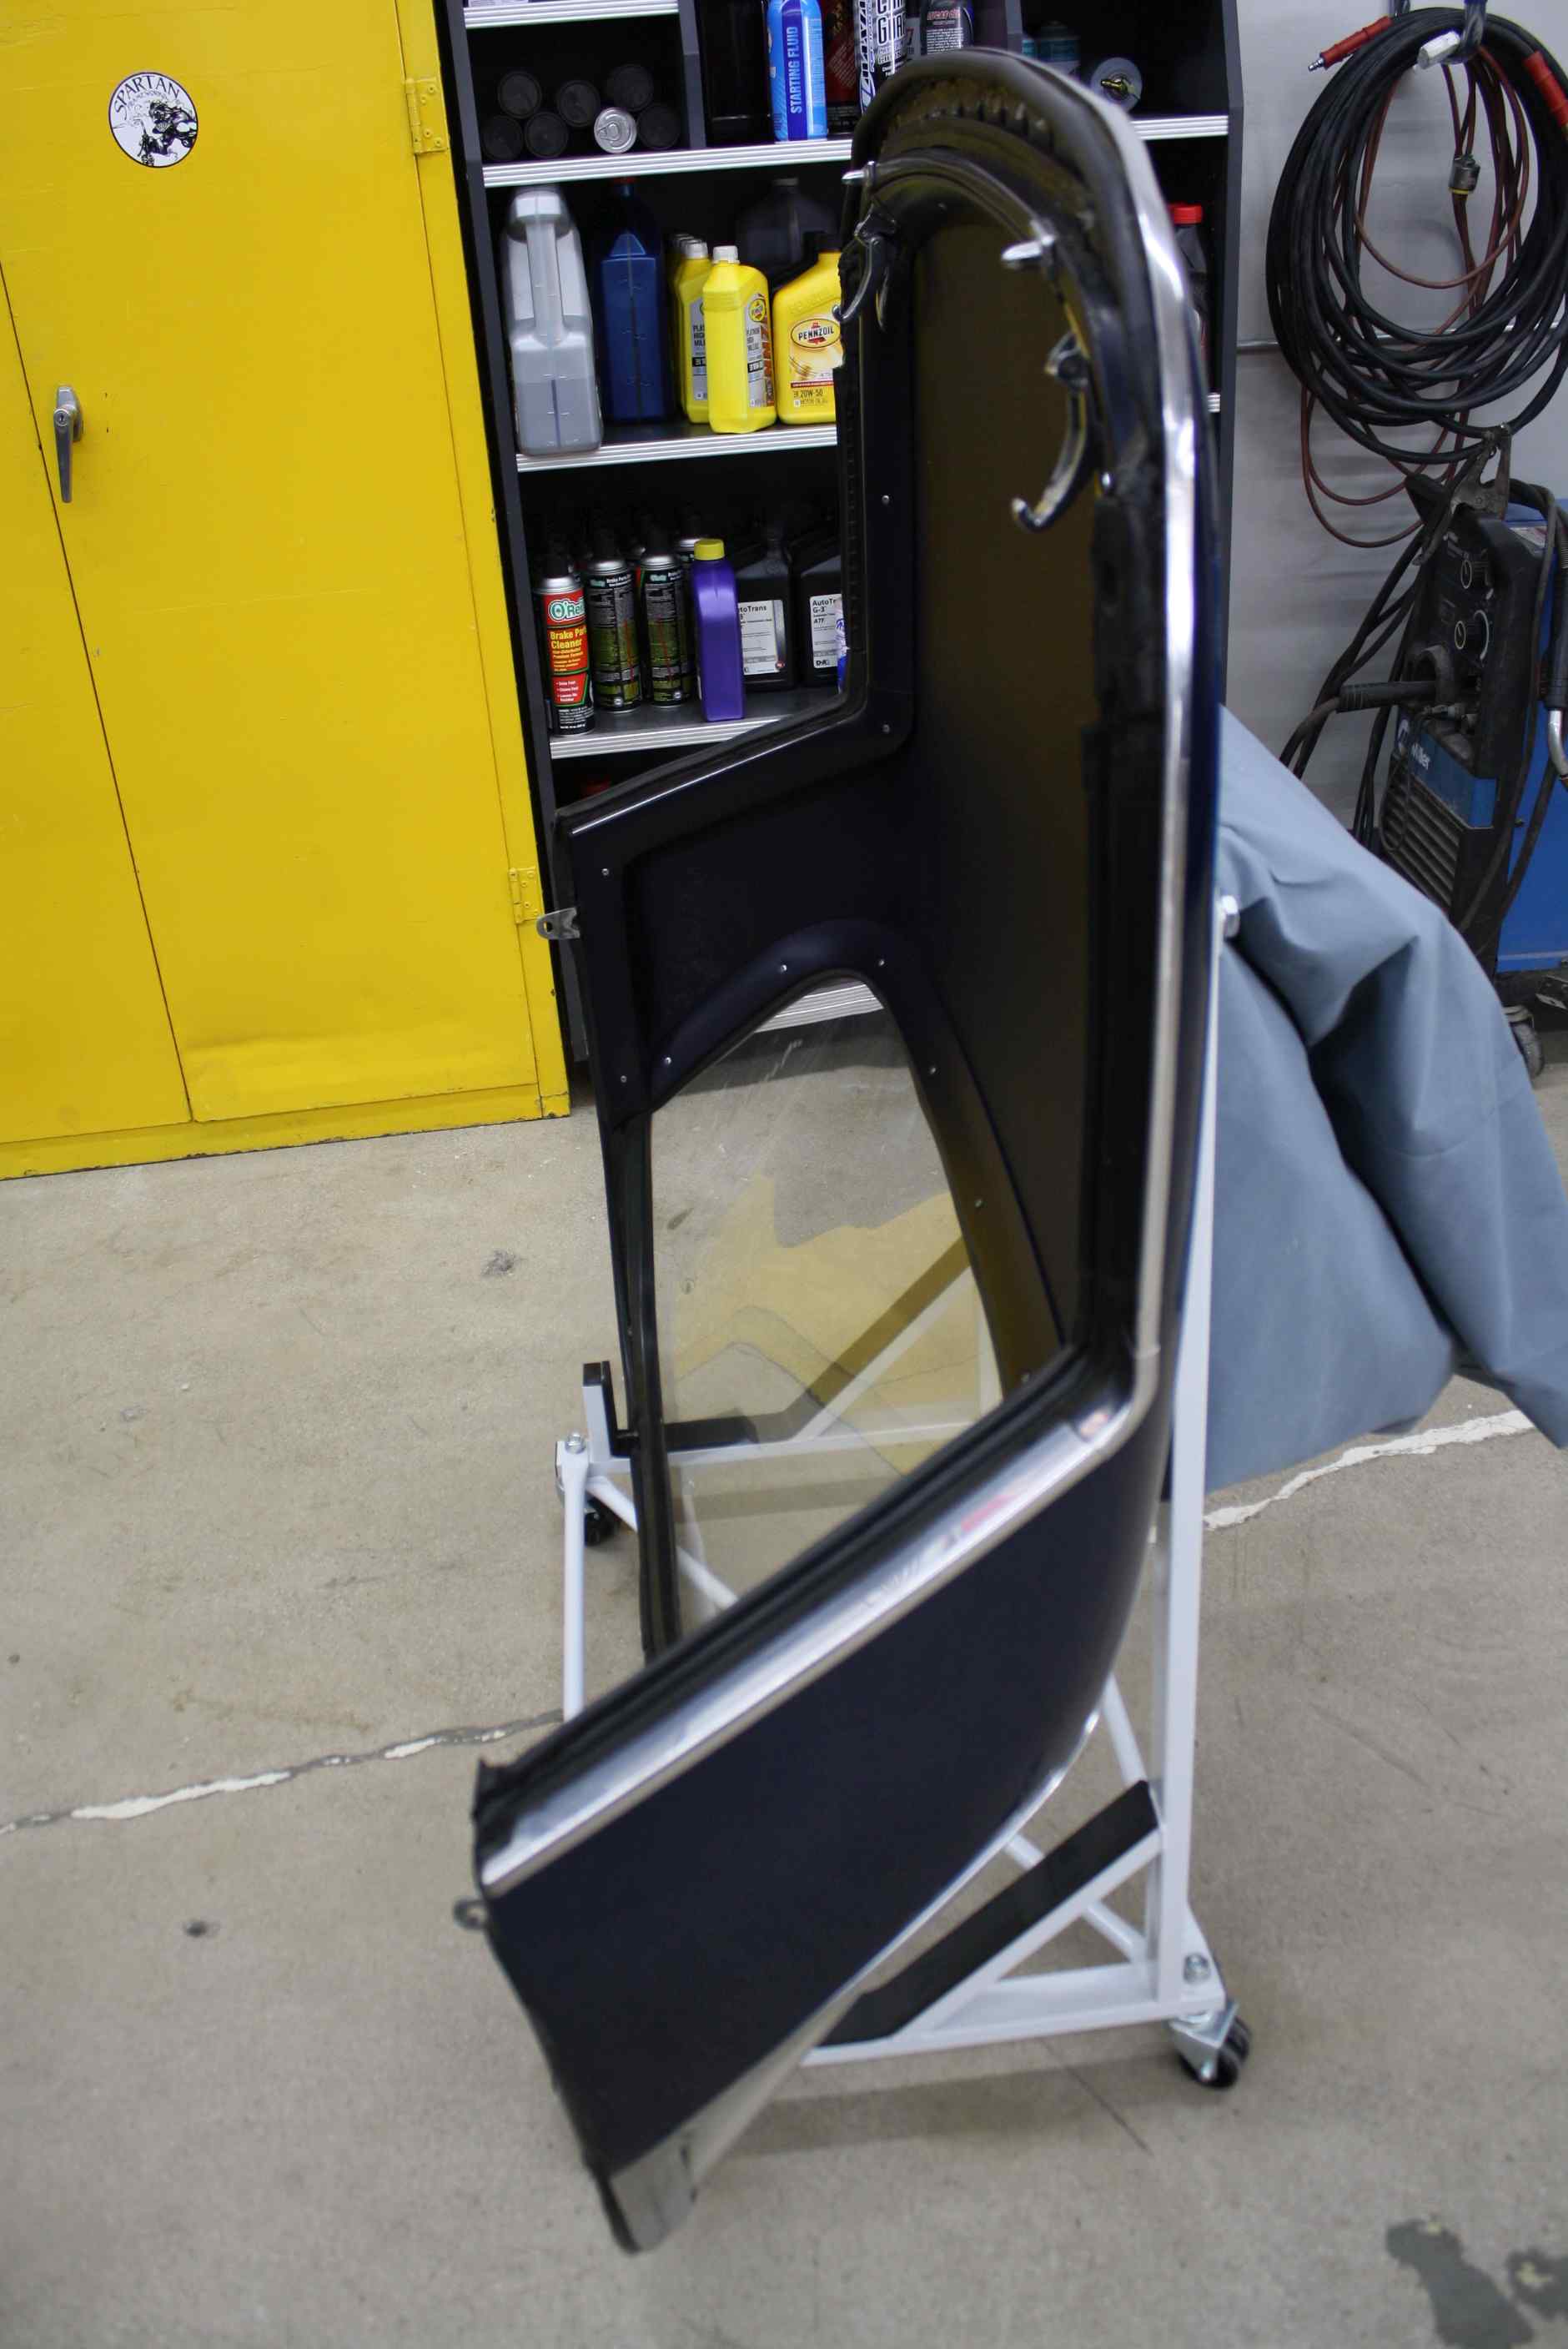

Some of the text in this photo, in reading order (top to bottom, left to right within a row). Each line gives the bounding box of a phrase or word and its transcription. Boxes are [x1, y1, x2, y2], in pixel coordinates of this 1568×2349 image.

[787, 26, 802, 114] STARTING FLUID
[114, 75, 180, 120] SPARTAN
[798, 328, 835, 340] PENNZOIL
[550, 631, 574, 640] Brake
[550, 639, 582, 649] Cleaner
